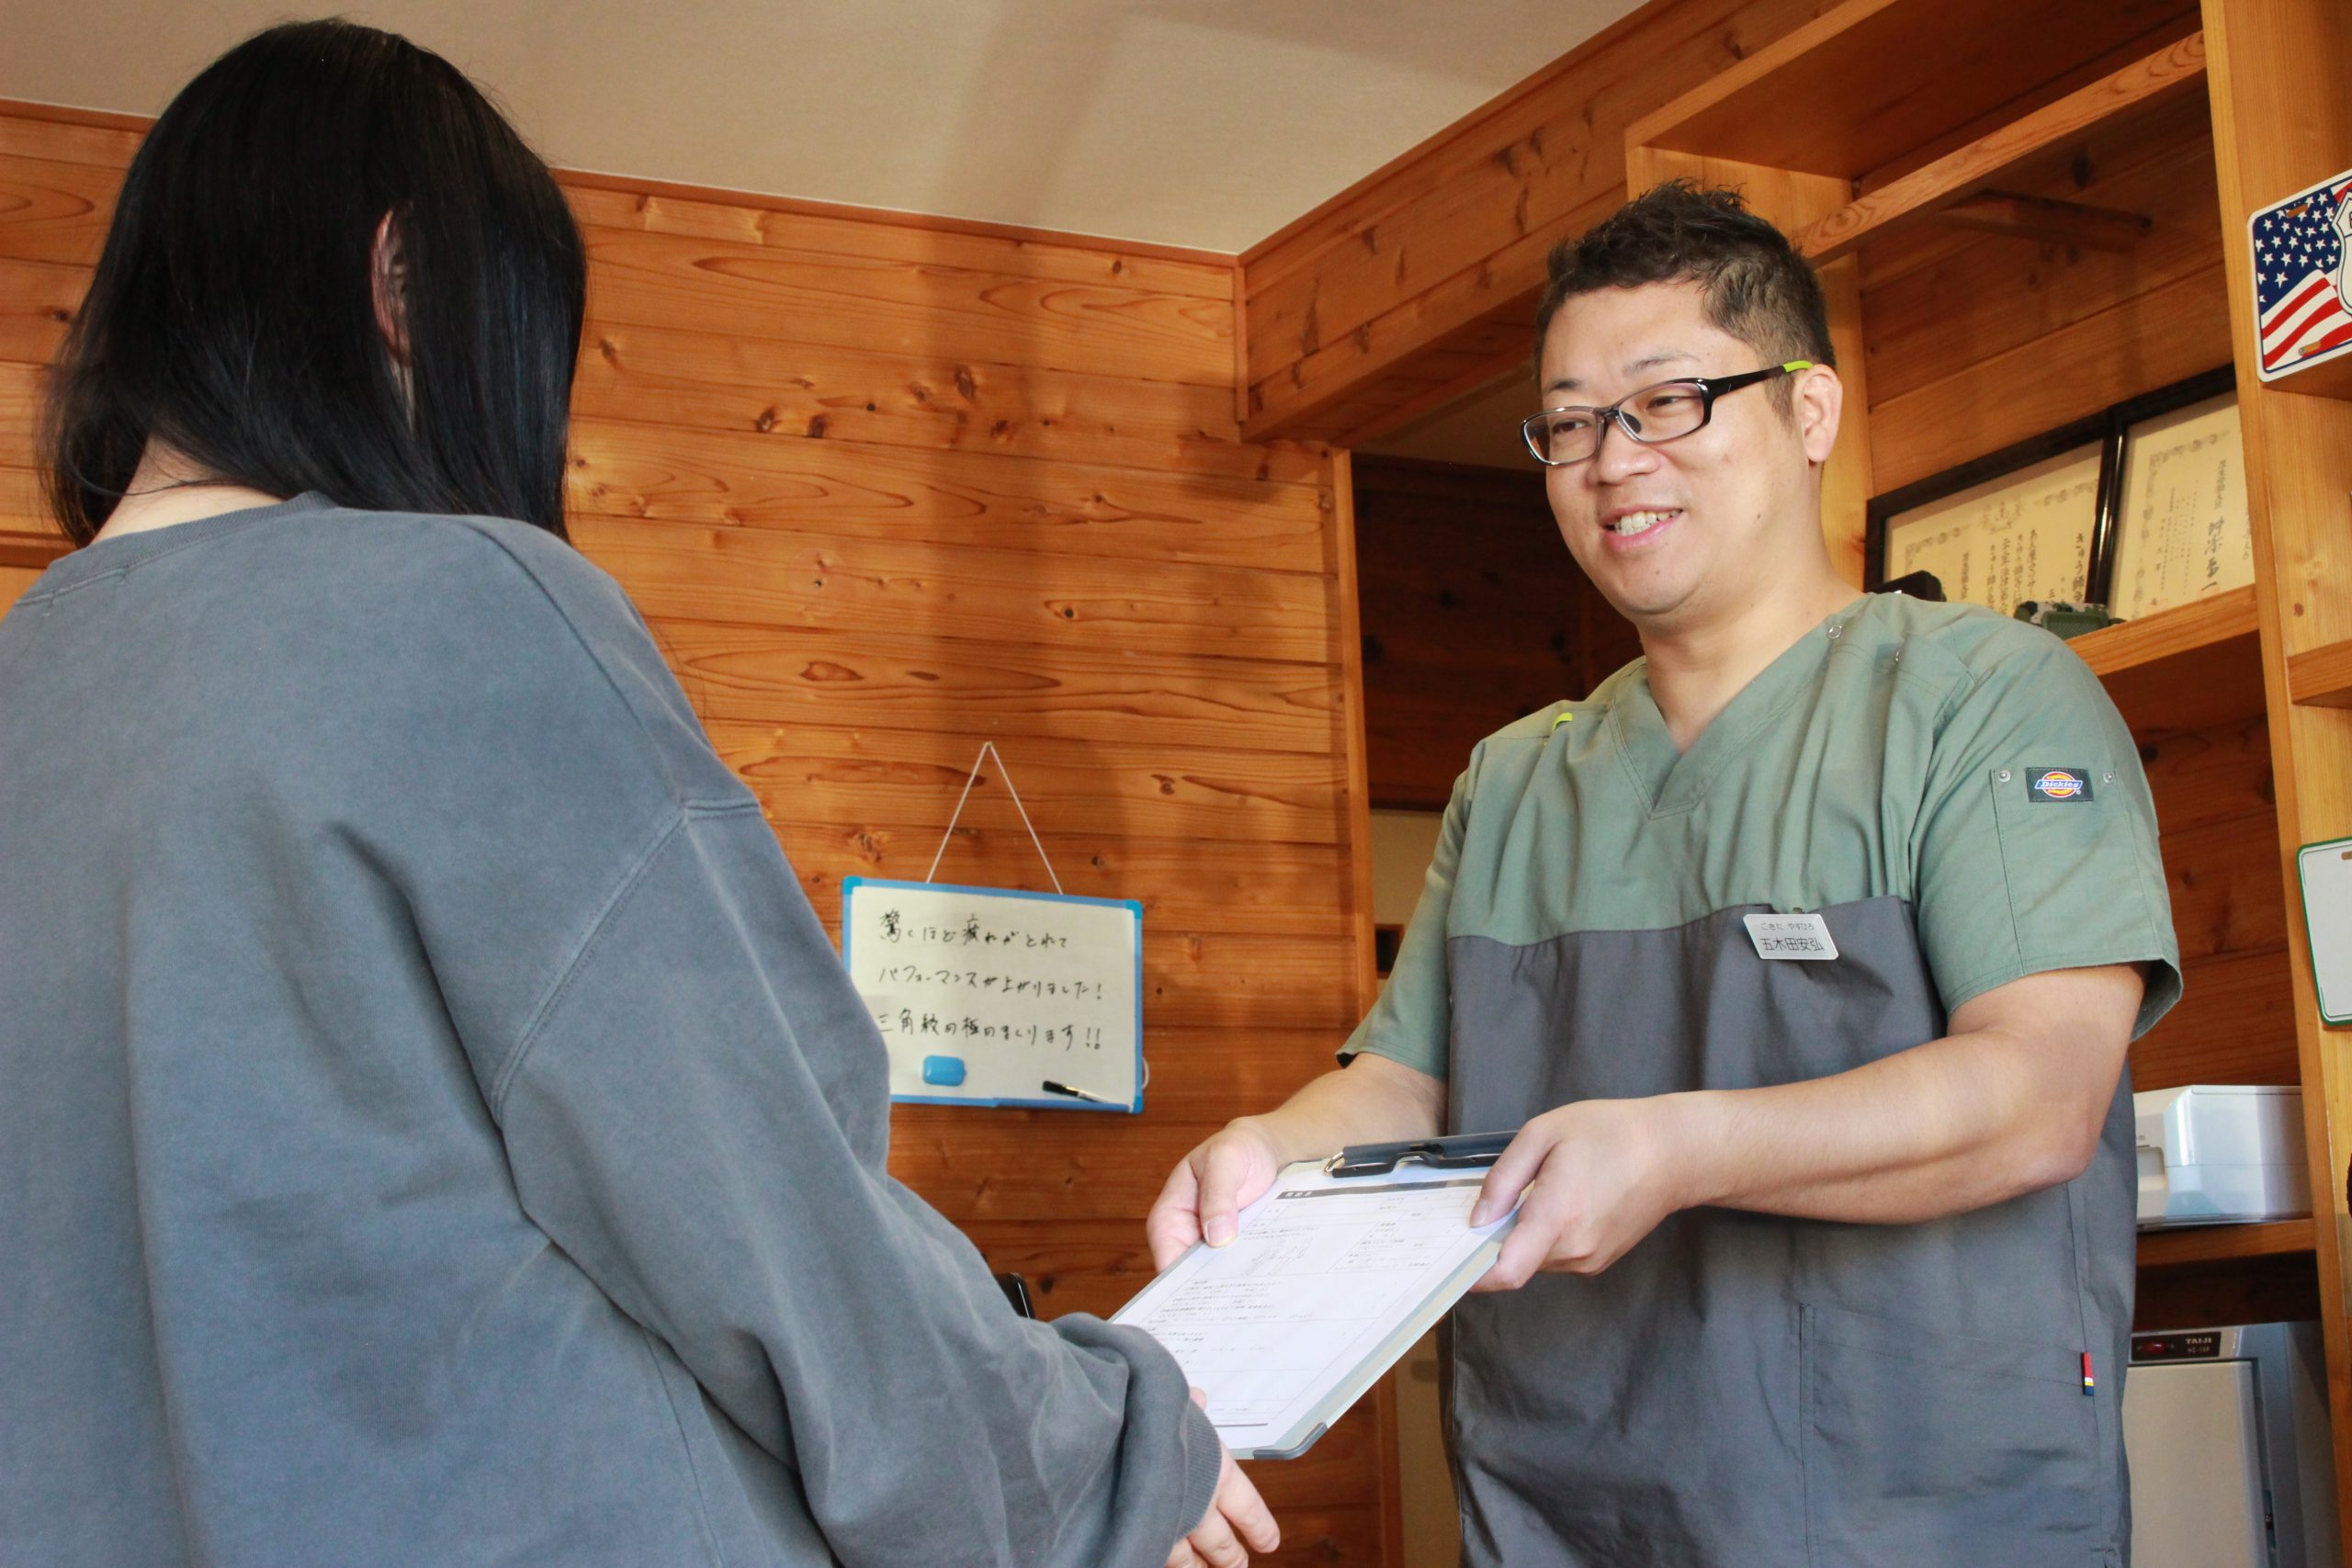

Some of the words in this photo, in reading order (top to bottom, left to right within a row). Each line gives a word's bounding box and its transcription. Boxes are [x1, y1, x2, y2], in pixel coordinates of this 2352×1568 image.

[1759, 938, 1824, 951] 五木田安弘
